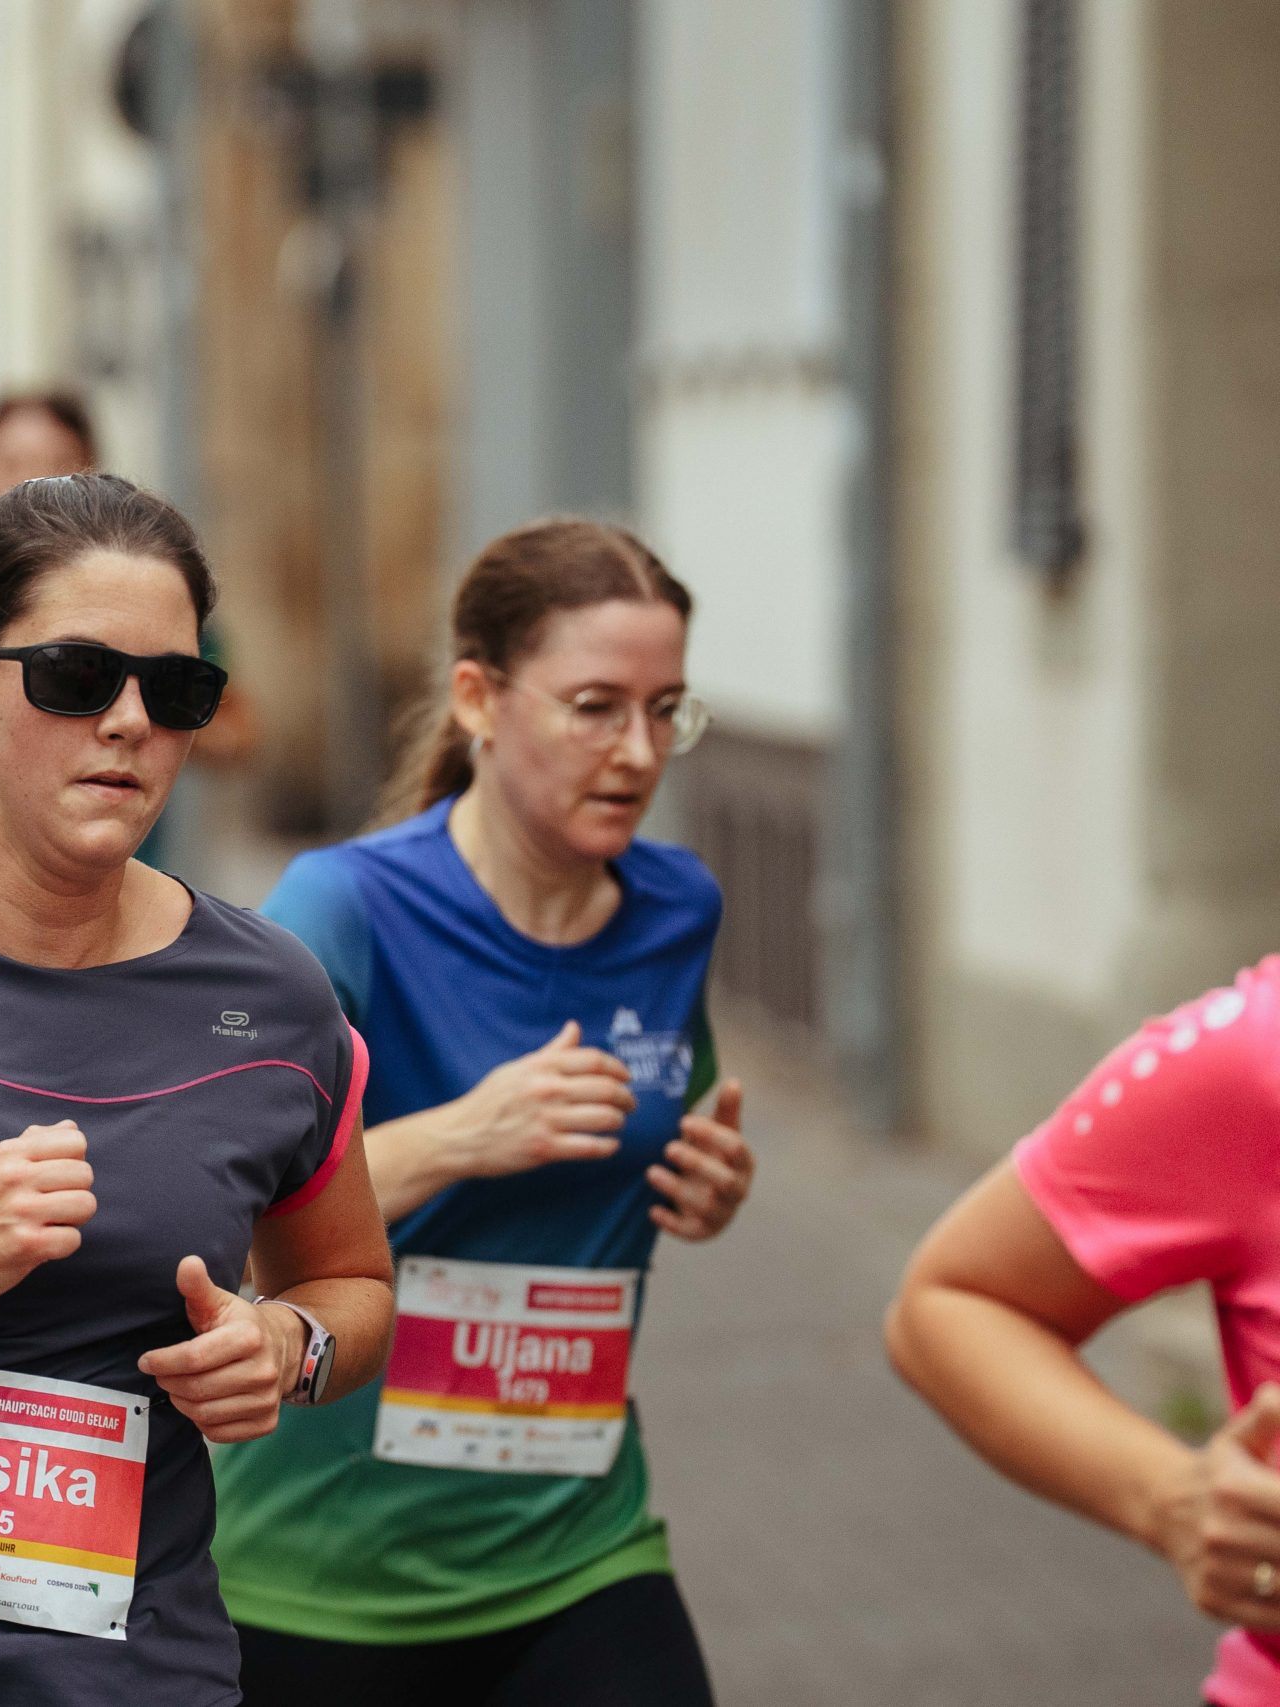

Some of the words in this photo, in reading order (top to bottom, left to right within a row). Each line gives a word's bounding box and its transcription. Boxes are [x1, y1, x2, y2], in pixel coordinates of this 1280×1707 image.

[212, 1025, 258, 1040] Kalenji
[452, 1322, 595, 1382] Uljana
[58, 1408, 85, 1424] GUDD
[86, 1413, 120, 1430] GELAAF
[0, 1543, 16, 1553] UHR
[0, 1573, 38, 1586] Kaufland
[46, 1579, 74, 1590] COSMOS
